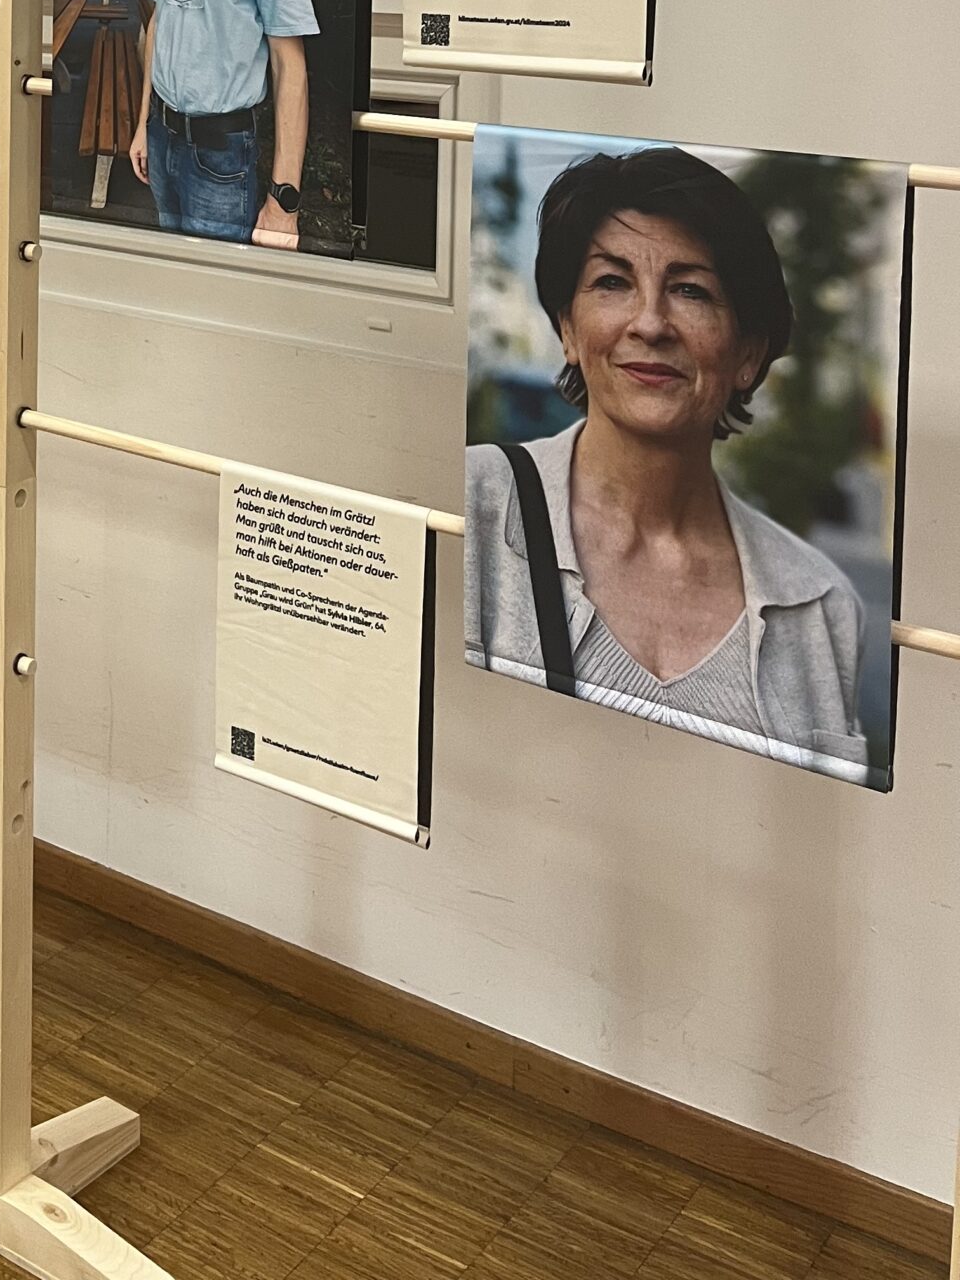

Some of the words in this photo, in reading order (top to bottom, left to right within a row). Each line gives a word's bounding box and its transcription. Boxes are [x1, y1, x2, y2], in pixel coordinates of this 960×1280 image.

[236, 498, 265, 514] haben
[266, 507, 285, 520] sich
[287, 512, 327, 530] dadurch
[329, 525, 381, 544] verändert:
[263, 490, 277, 502] die
[278, 494, 328, 514] Menschen
[329, 506, 342, 518] im
[344, 509, 375, 526] Grätzl
[235, 514, 257, 528] Man
[258, 522, 285, 535] grüßt
[286, 529, 306, 540] und
[307, 533, 343, 550] tauscht
[344, 543, 364, 556] sich
[365, 550, 386, 563] aus,
[235, 545, 255, 559] haft
[256, 551, 270, 563] als
[235, 531, 256, 543] man
[257, 535, 277, 549] hilft
[278, 540, 293, 553] bei
[293, 545, 337, 565] Aktionen
[339, 559, 363, 571] oder
[364, 564, 398, 579] dauer-
[234, 571, 245, 581] Als
[281, 586, 295, 595] und
[295, 588, 344, 608] Co-Sprecherin
[344, 603, 357, 612] der
[357, 606, 389, 620] Agenda-
[234, 582, 258, 595] Gruppe
[278, 596, 293, 605] wird
[314, 604, 326, 615] hat
[330, 622, 366, 637] verändert.
